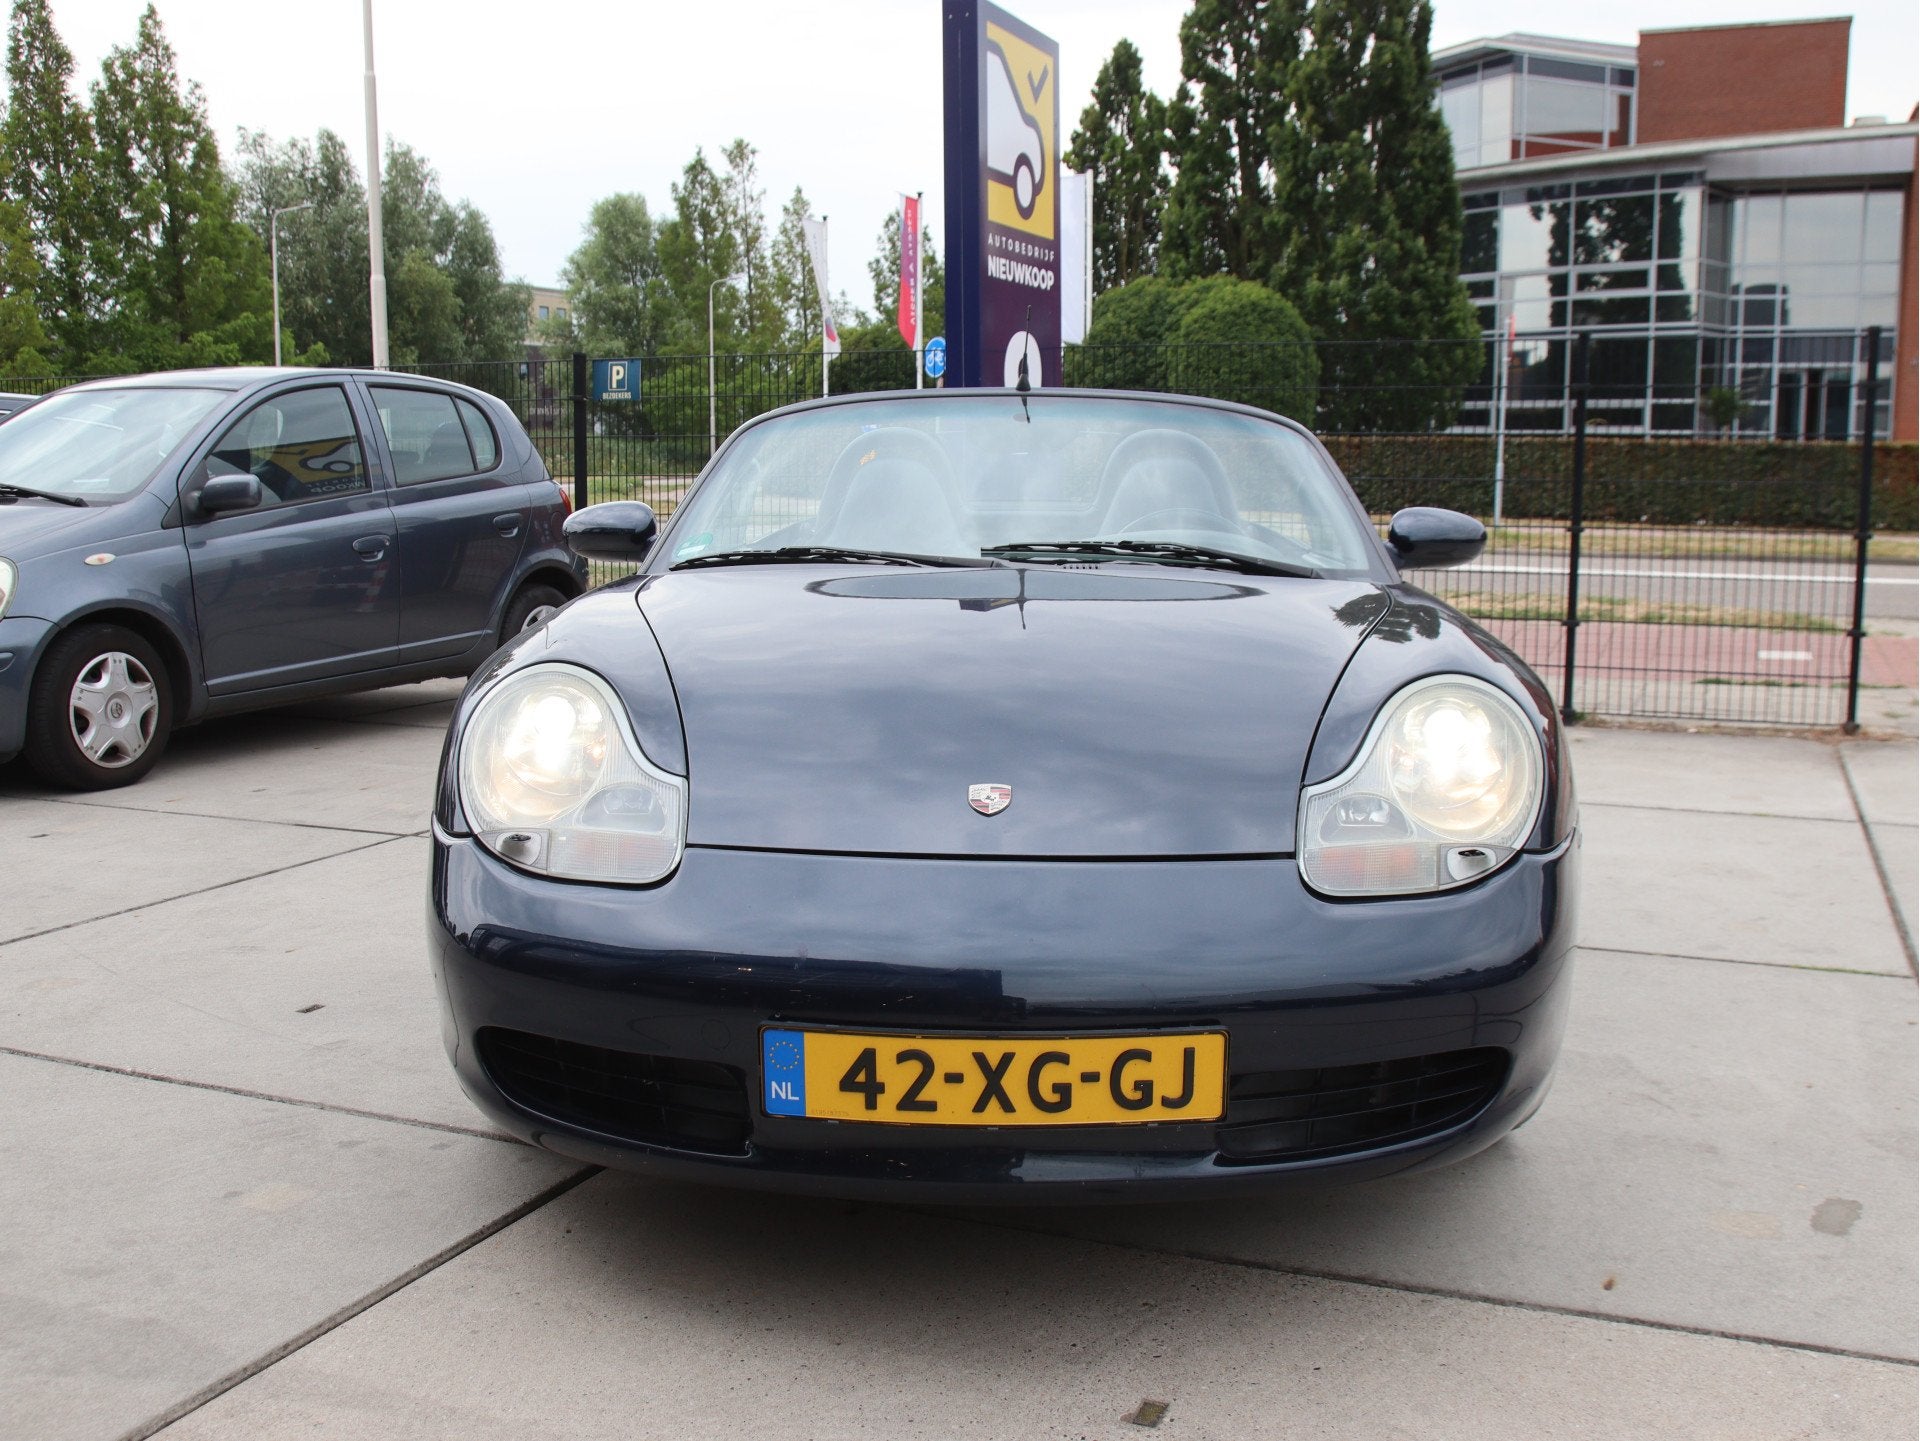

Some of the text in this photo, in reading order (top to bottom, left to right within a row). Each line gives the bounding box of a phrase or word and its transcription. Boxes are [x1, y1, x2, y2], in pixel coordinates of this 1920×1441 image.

[988, 232, 1055, 262] AUTOBEDRIJF
[987, 254, 1054, 291] NIEUWKOOP
[612, 365, 625, 388] P
[602, 391, 632, 400] BEZOEKERS
[770, 1081, 799, 1101] NL
[838, 1046, 1197, 1114] 42-XG-GJ
